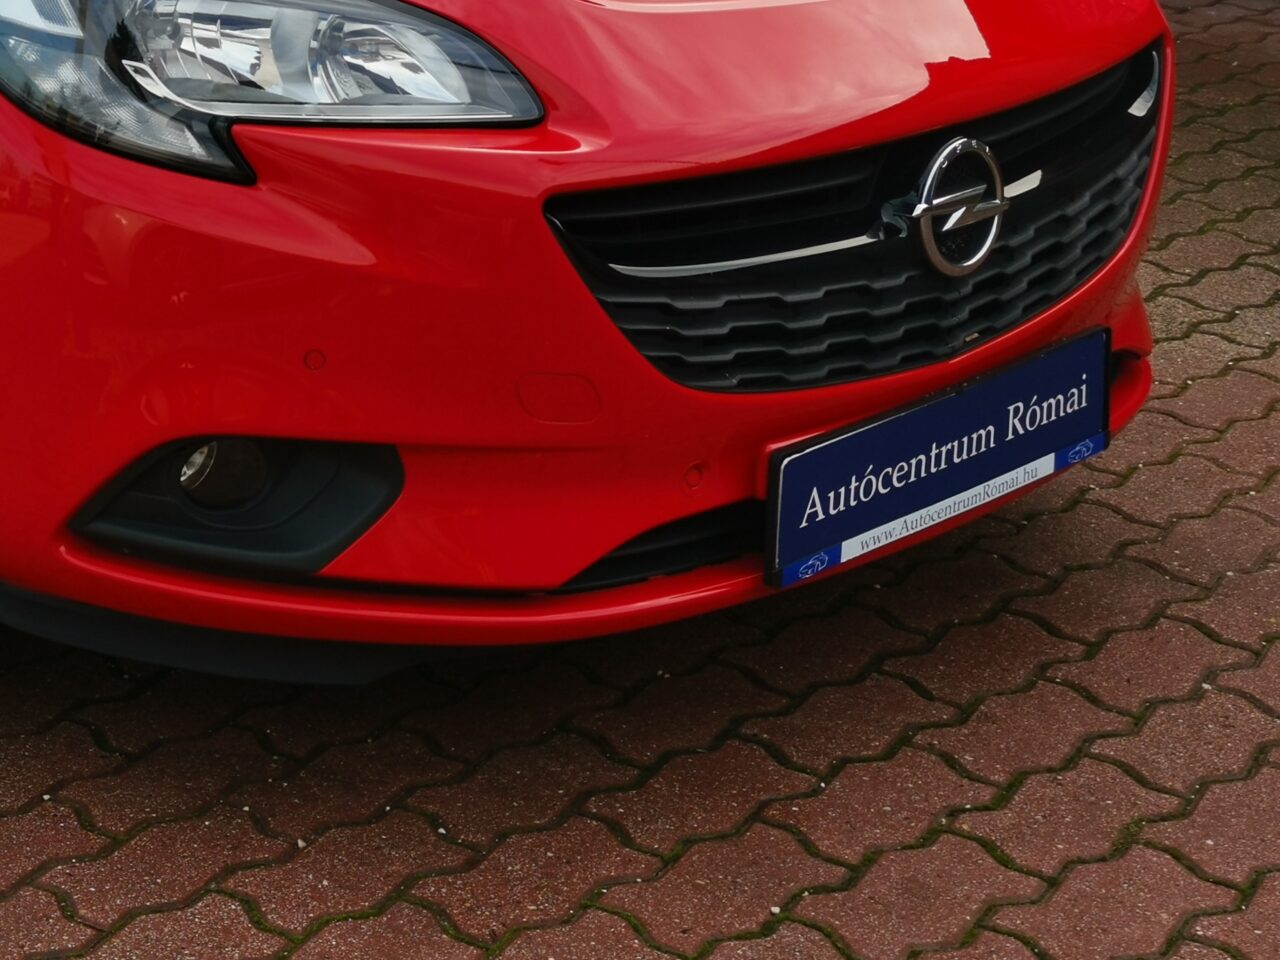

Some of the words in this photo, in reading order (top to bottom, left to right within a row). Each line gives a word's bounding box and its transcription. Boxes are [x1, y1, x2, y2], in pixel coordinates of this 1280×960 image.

[799, 422, 997, 529] Autócentrum
[1006, 373, 1090, 442] Római
[859, 465, 1039, 553] www.AutócentrumRómai.hu
